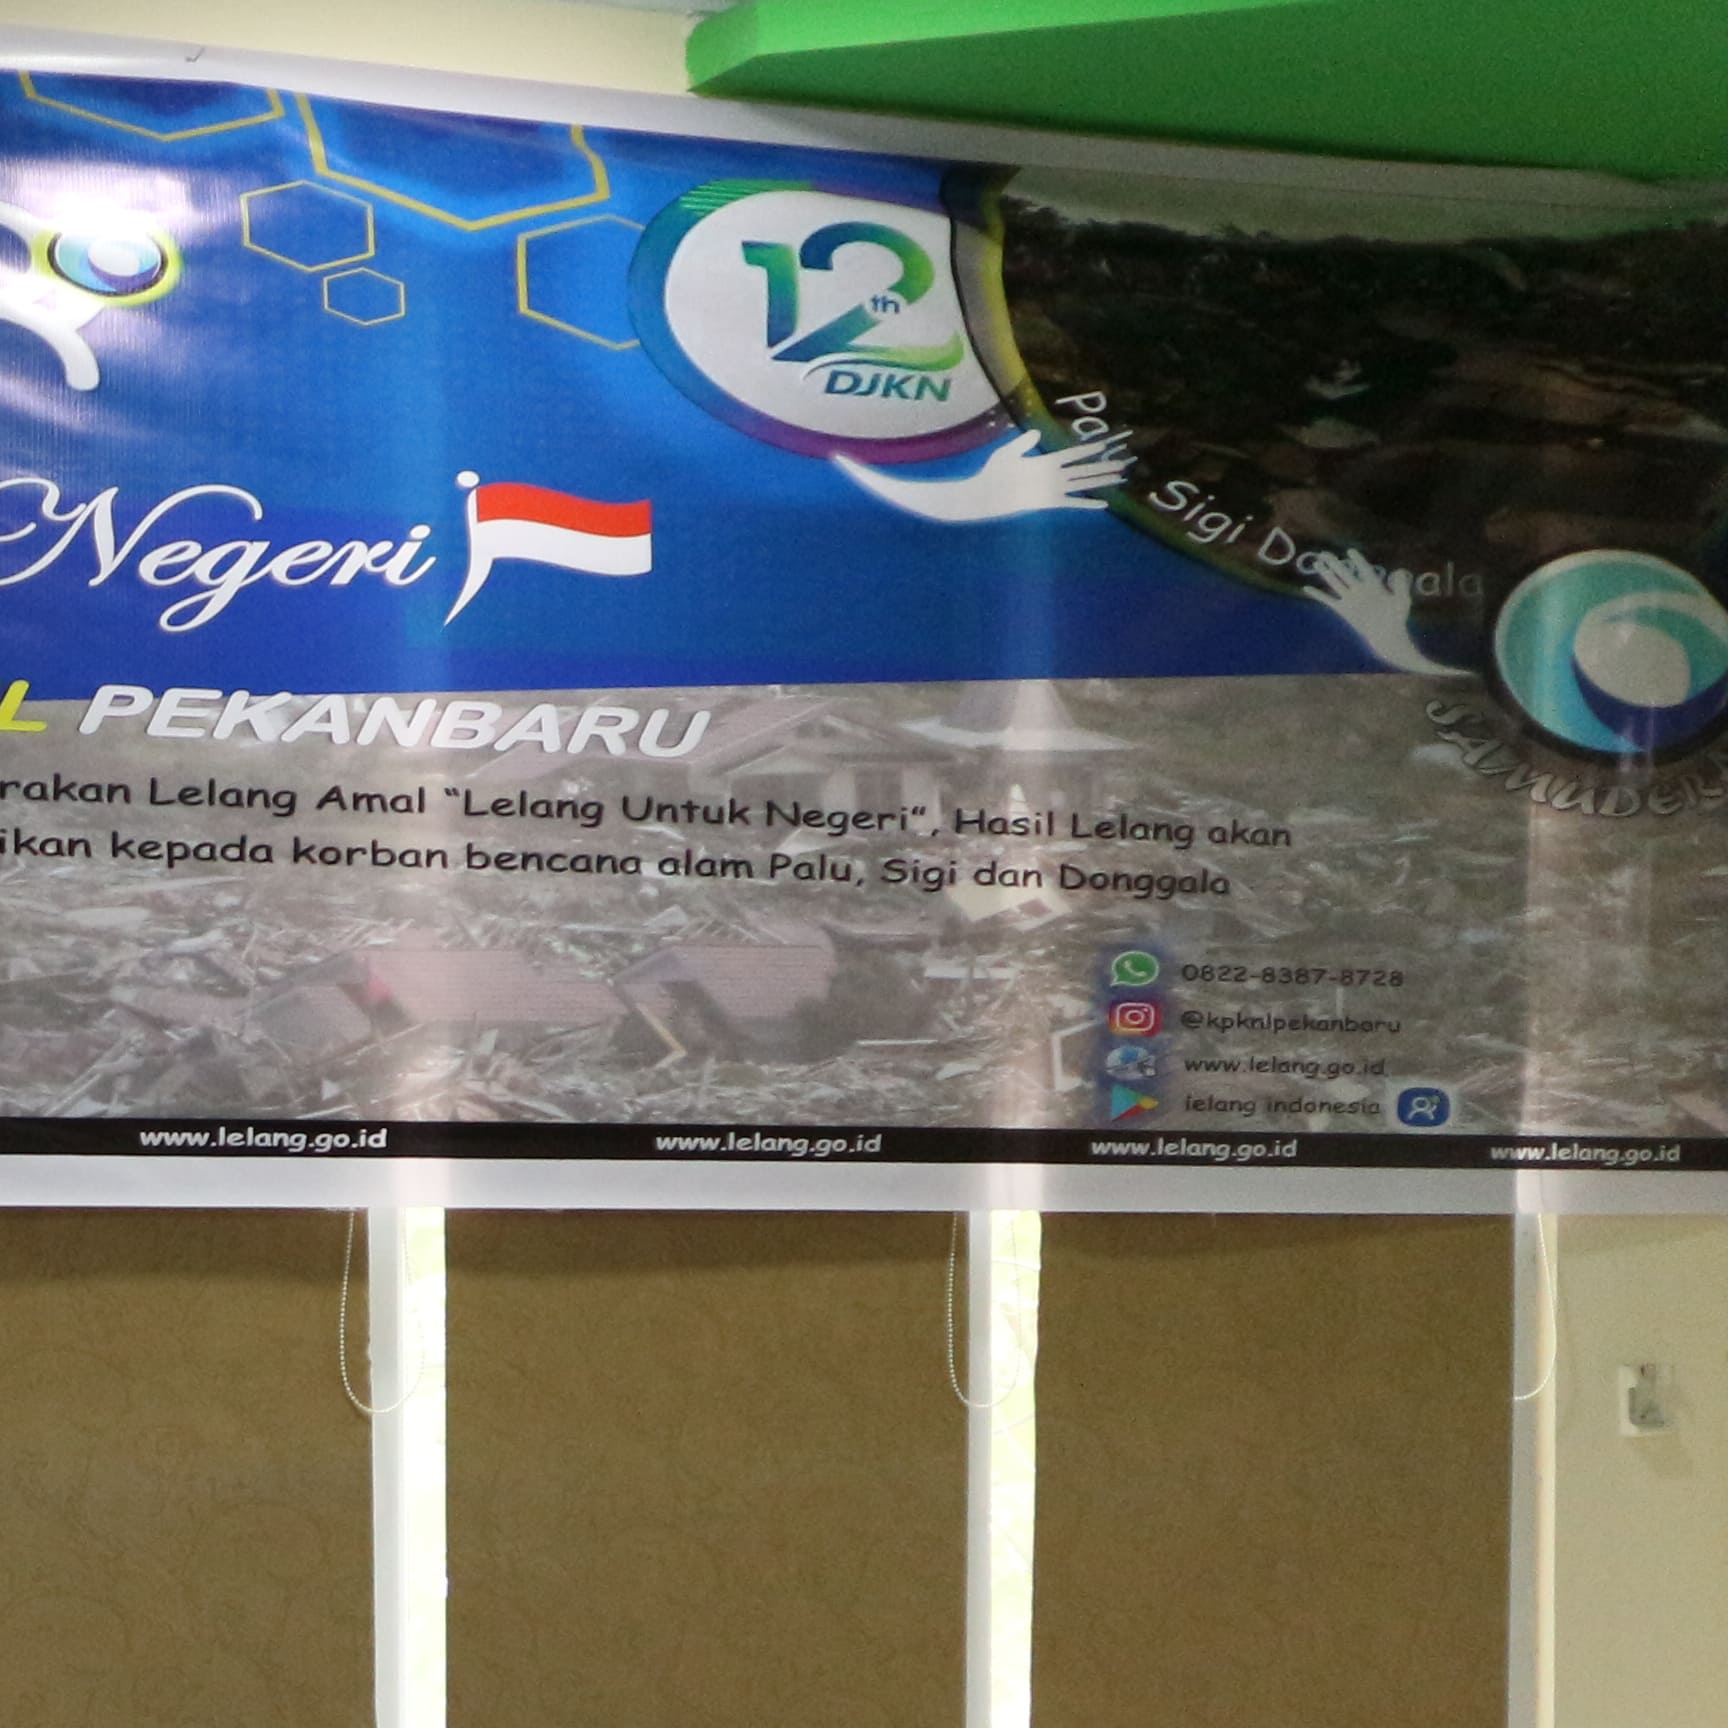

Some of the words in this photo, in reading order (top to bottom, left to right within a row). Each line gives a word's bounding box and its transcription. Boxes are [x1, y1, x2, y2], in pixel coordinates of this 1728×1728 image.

[741, 221, 963, 362] 12
[824, 369, 953, 402] DJKN
[1149, 480, 1254, 544] Sigi
[1258, 526, 1483, 597] Doala
[78, 683, 712, 759] PEKANBARU
[1425, 700, 1728, 818] SAMUDER
[149, 777, 297, 817] Lelang
[317, 784, 425, 815] Amal
[622, 796, 750, 827] Untuk
[954, 808, 1055, 839] Hasil
[1072, 812, 1196, 849] Lelang
[1208, 817, 1292, 848] akan
[112, 829, 274, 868] kepada
[292, 837, 448, 870] korban
[466, 843, 643, 876] bencana
[657, 851, 754, 879] alam
[770, 855, 864, 888] Palu,
[880, 858, 957, 893] Sigi
[974, 860, 1043, 890] dan
[1059, 863, 1231, 901] Donggala
[139, 1126, 388, 1154] www.lelang.go.id
[654, 1131, 883, 1159] www.lelang.go.id
[1090, 1136, 1299, 1165] www.lelang.go.id
[1490, 1140, 1681, 1167] www.lelang.go.id
